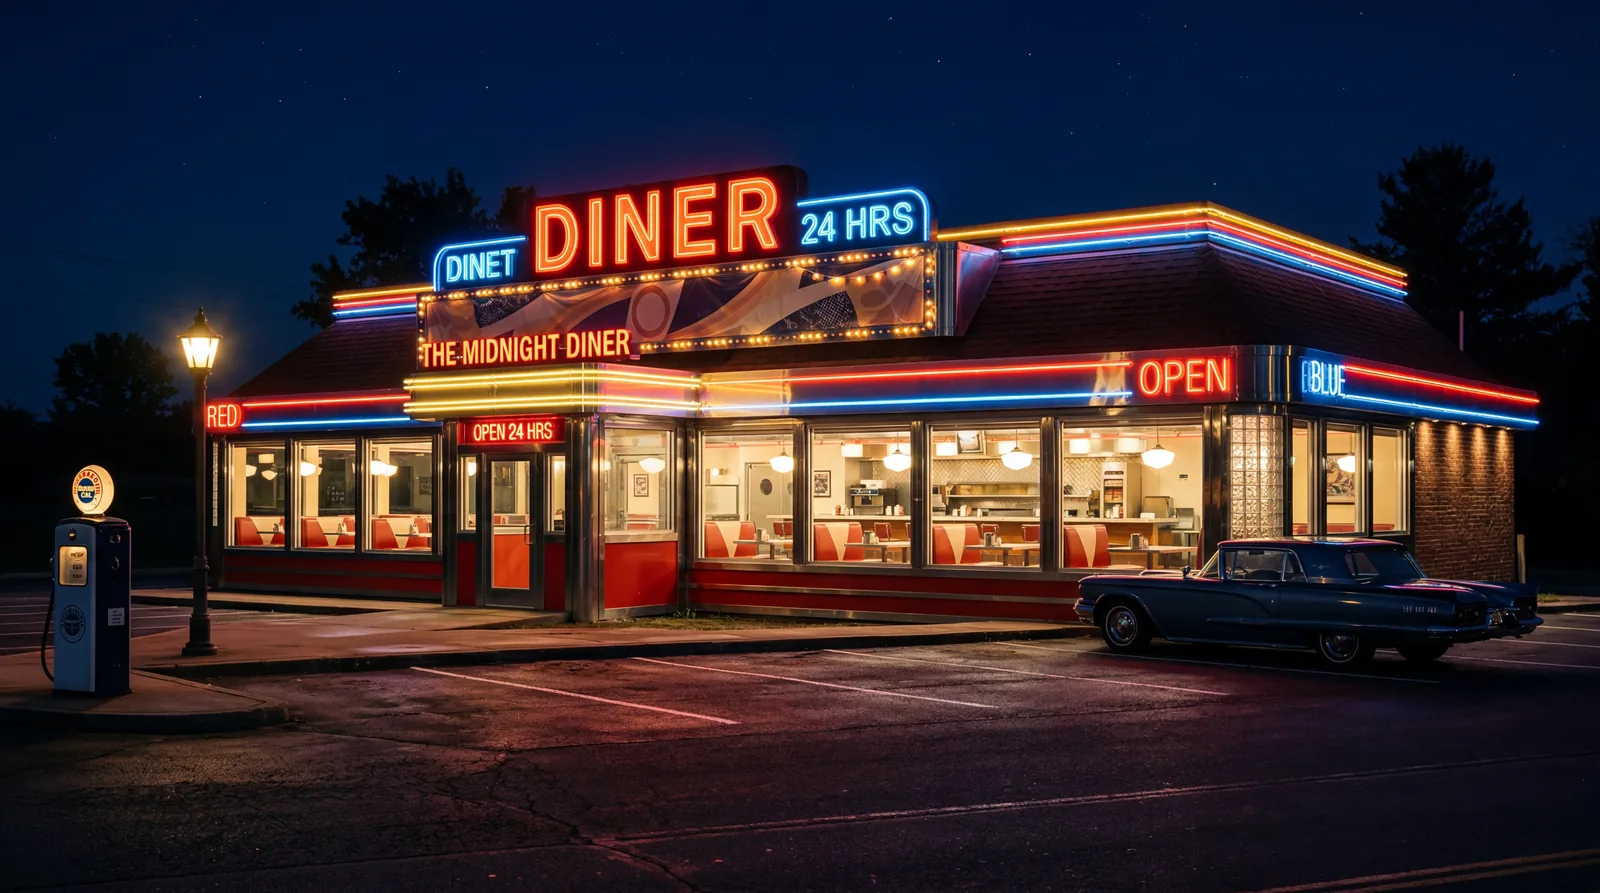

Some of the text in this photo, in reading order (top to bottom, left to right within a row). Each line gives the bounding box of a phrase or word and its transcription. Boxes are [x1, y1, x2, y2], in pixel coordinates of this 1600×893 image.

[534, 176, 778, 274] DINER
[801, 201, 914, 245] 24 HRS
[445, 248, 516, 283] DINET
[422, 328, 631, 368] THE MIDNIGHT DINER
[1139, 357, 1231, 395] OPEN
[1311, 359, 1346, 397] BLUE
[207, 404, 238, 428] RED
[473, 421, 553, 441] OPEN 24 HRS
